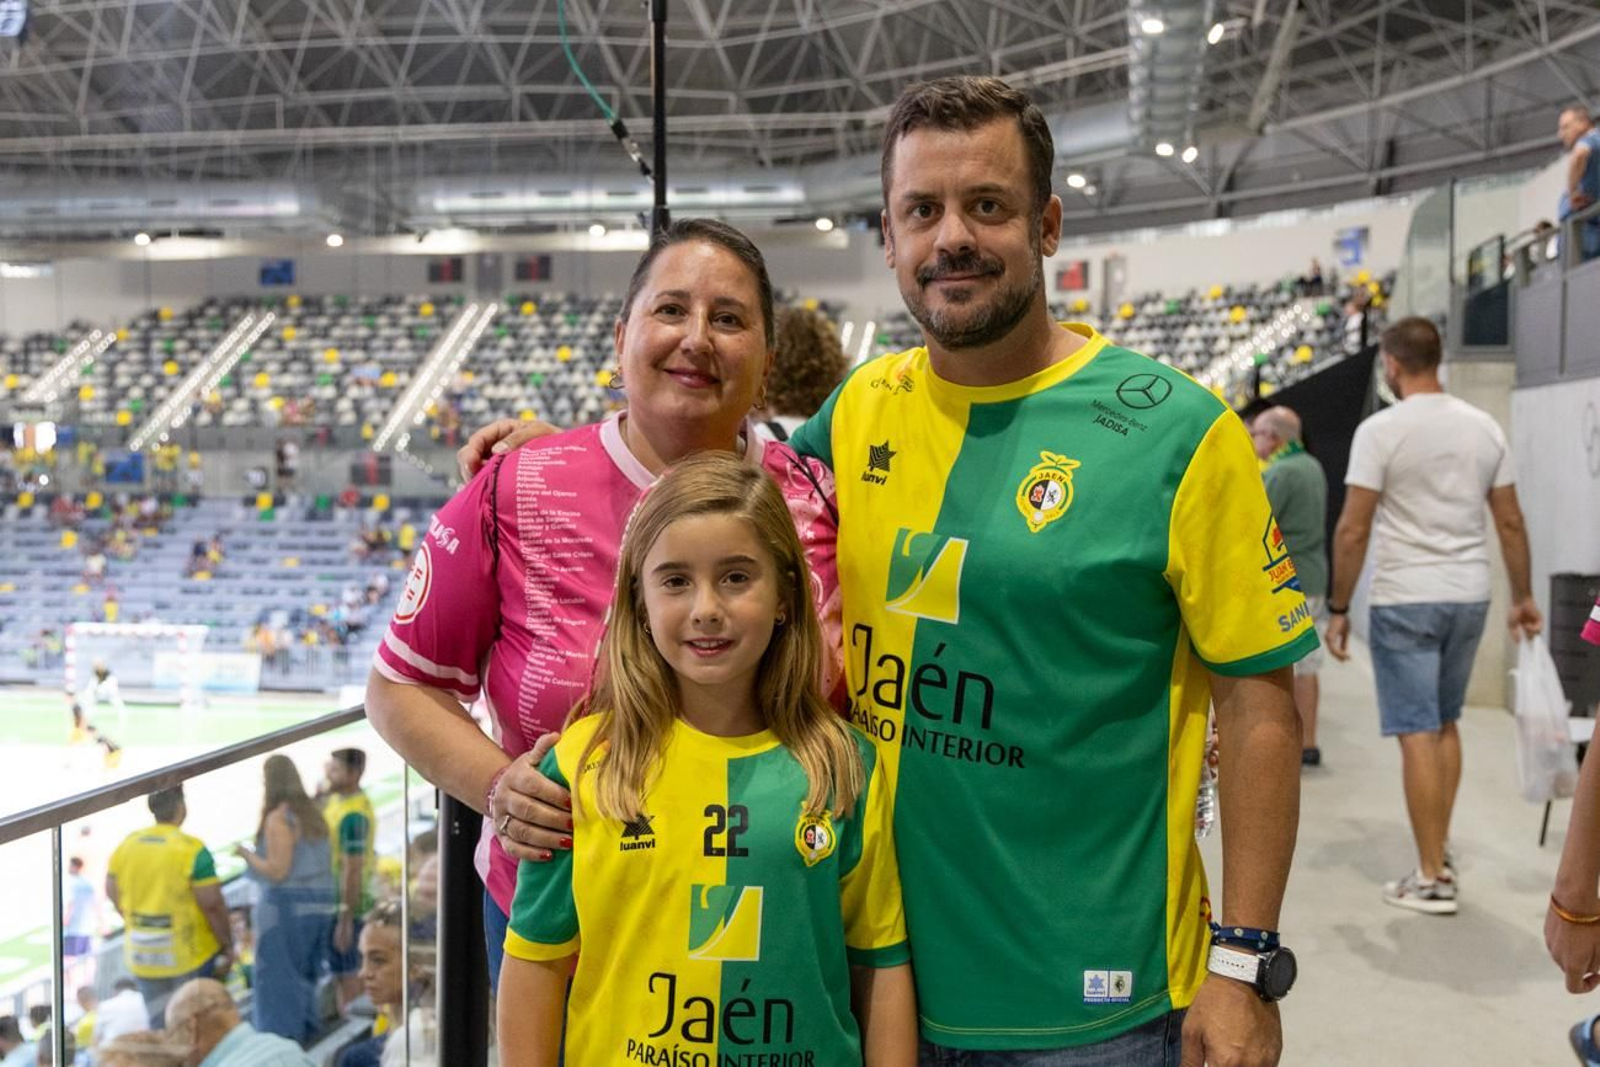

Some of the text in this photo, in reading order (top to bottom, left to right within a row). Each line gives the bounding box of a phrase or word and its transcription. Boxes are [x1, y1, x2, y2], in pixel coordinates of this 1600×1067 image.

[1093, 415, 1128, 436] JADISA
[852, 622, 995, 730] Jaén
[901, 723, 1026, 769] INTERIOR
[703, 803, 749, 857] 22
[648, 971, 795, 1046] Jaén
[626, 1038, 815, 1067] PARAÍSO INTERIOR
